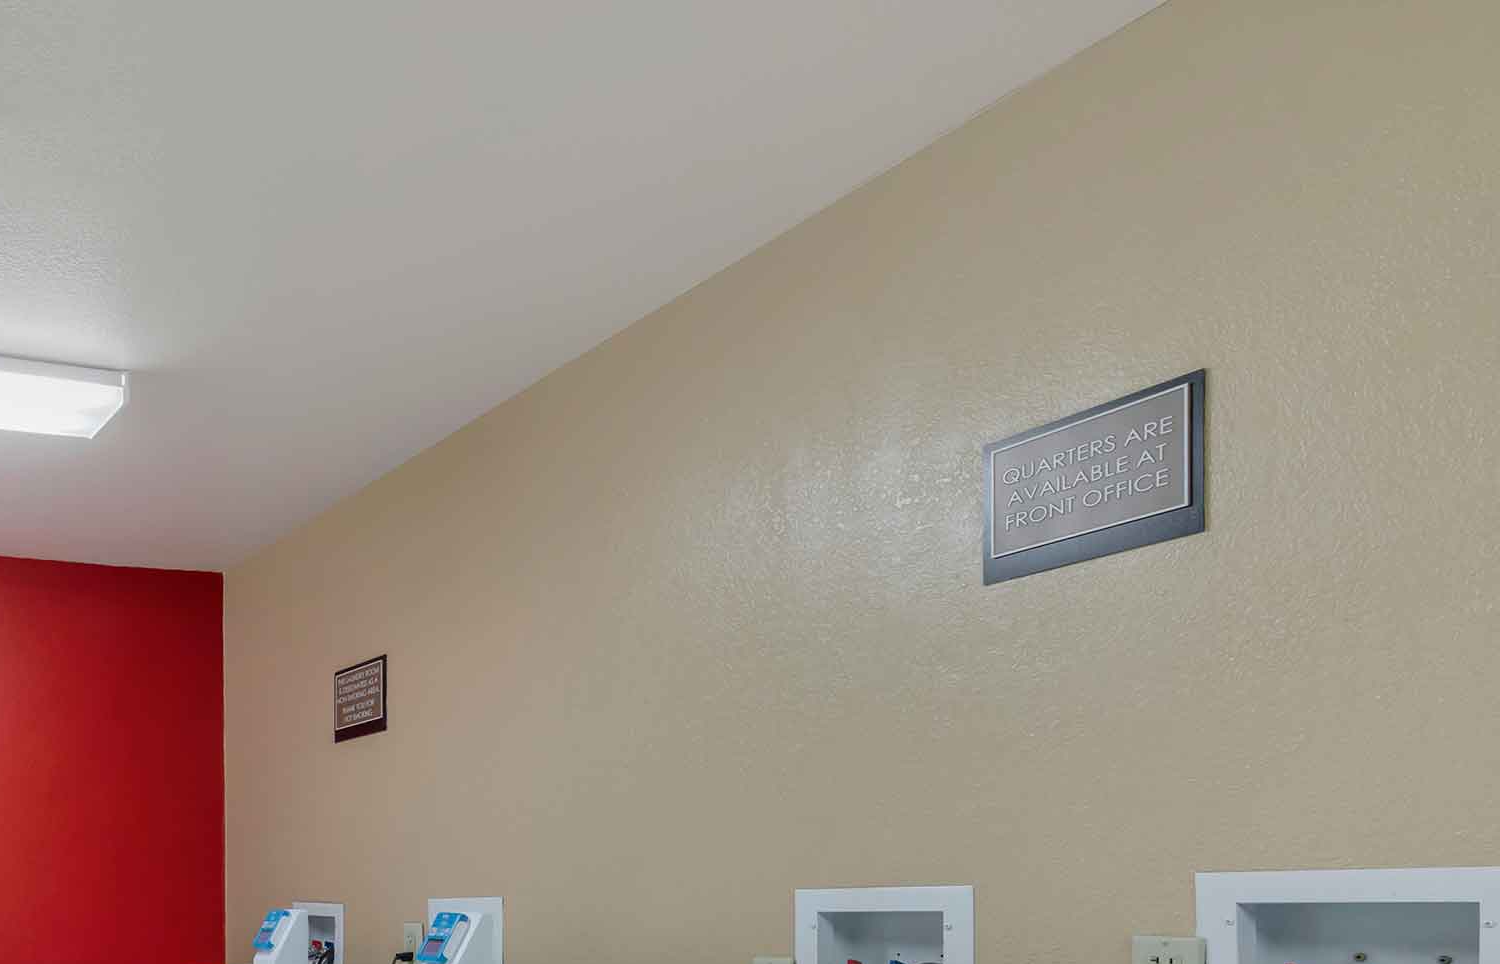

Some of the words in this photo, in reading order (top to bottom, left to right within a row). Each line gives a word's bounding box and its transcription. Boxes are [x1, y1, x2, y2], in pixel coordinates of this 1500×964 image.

[1002, 434, 1117, 485] QUARTERS
[1124, 415, 1174, 447] ARE
[1007, 455, 1128, 508] AVAILABLE
[1137, 443, 1167, 468] AT
[1005, 496, 1076, 531] FRONT
[1083, 468, 1170, 507] OFFICE
